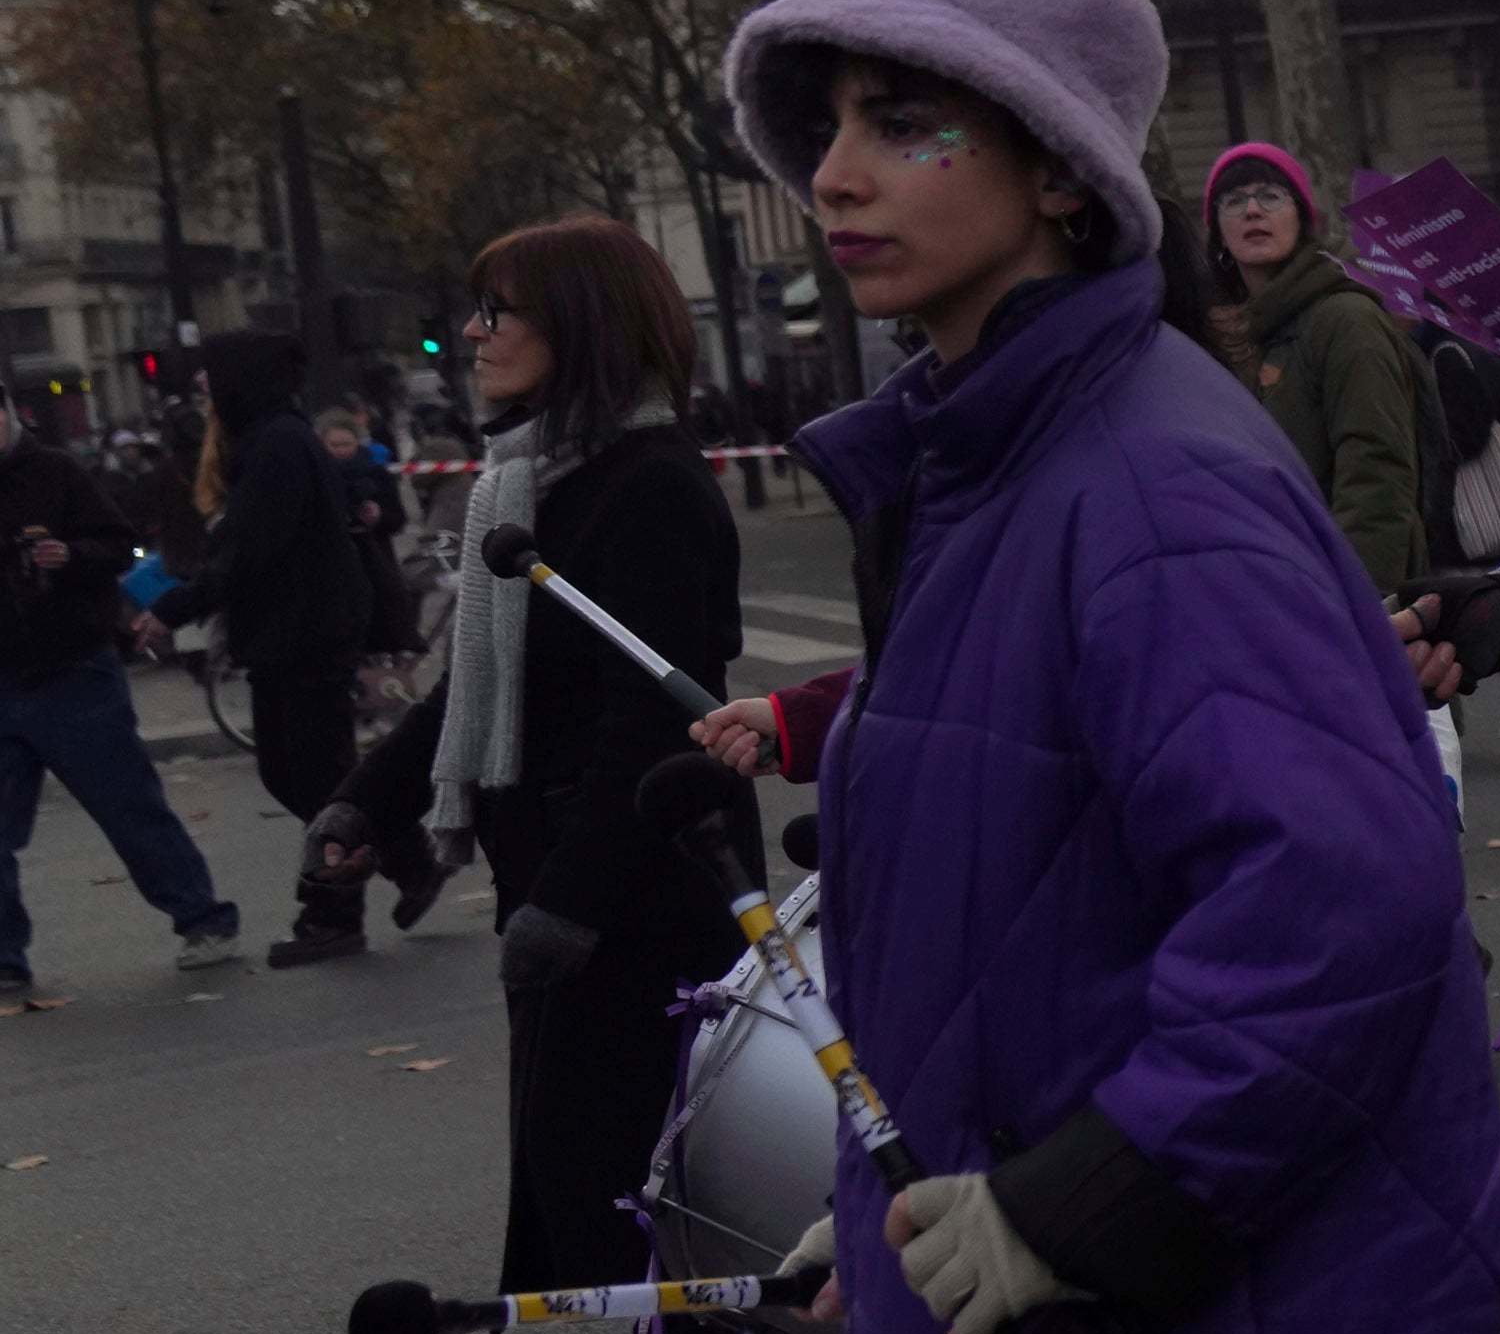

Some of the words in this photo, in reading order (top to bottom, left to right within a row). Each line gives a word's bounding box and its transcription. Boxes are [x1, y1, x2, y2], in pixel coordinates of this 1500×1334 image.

[1363, 214, 1389, 230] Le
[1386, 207, 1466, 250] féminisme
[1413, 251, 1439, 269] est
